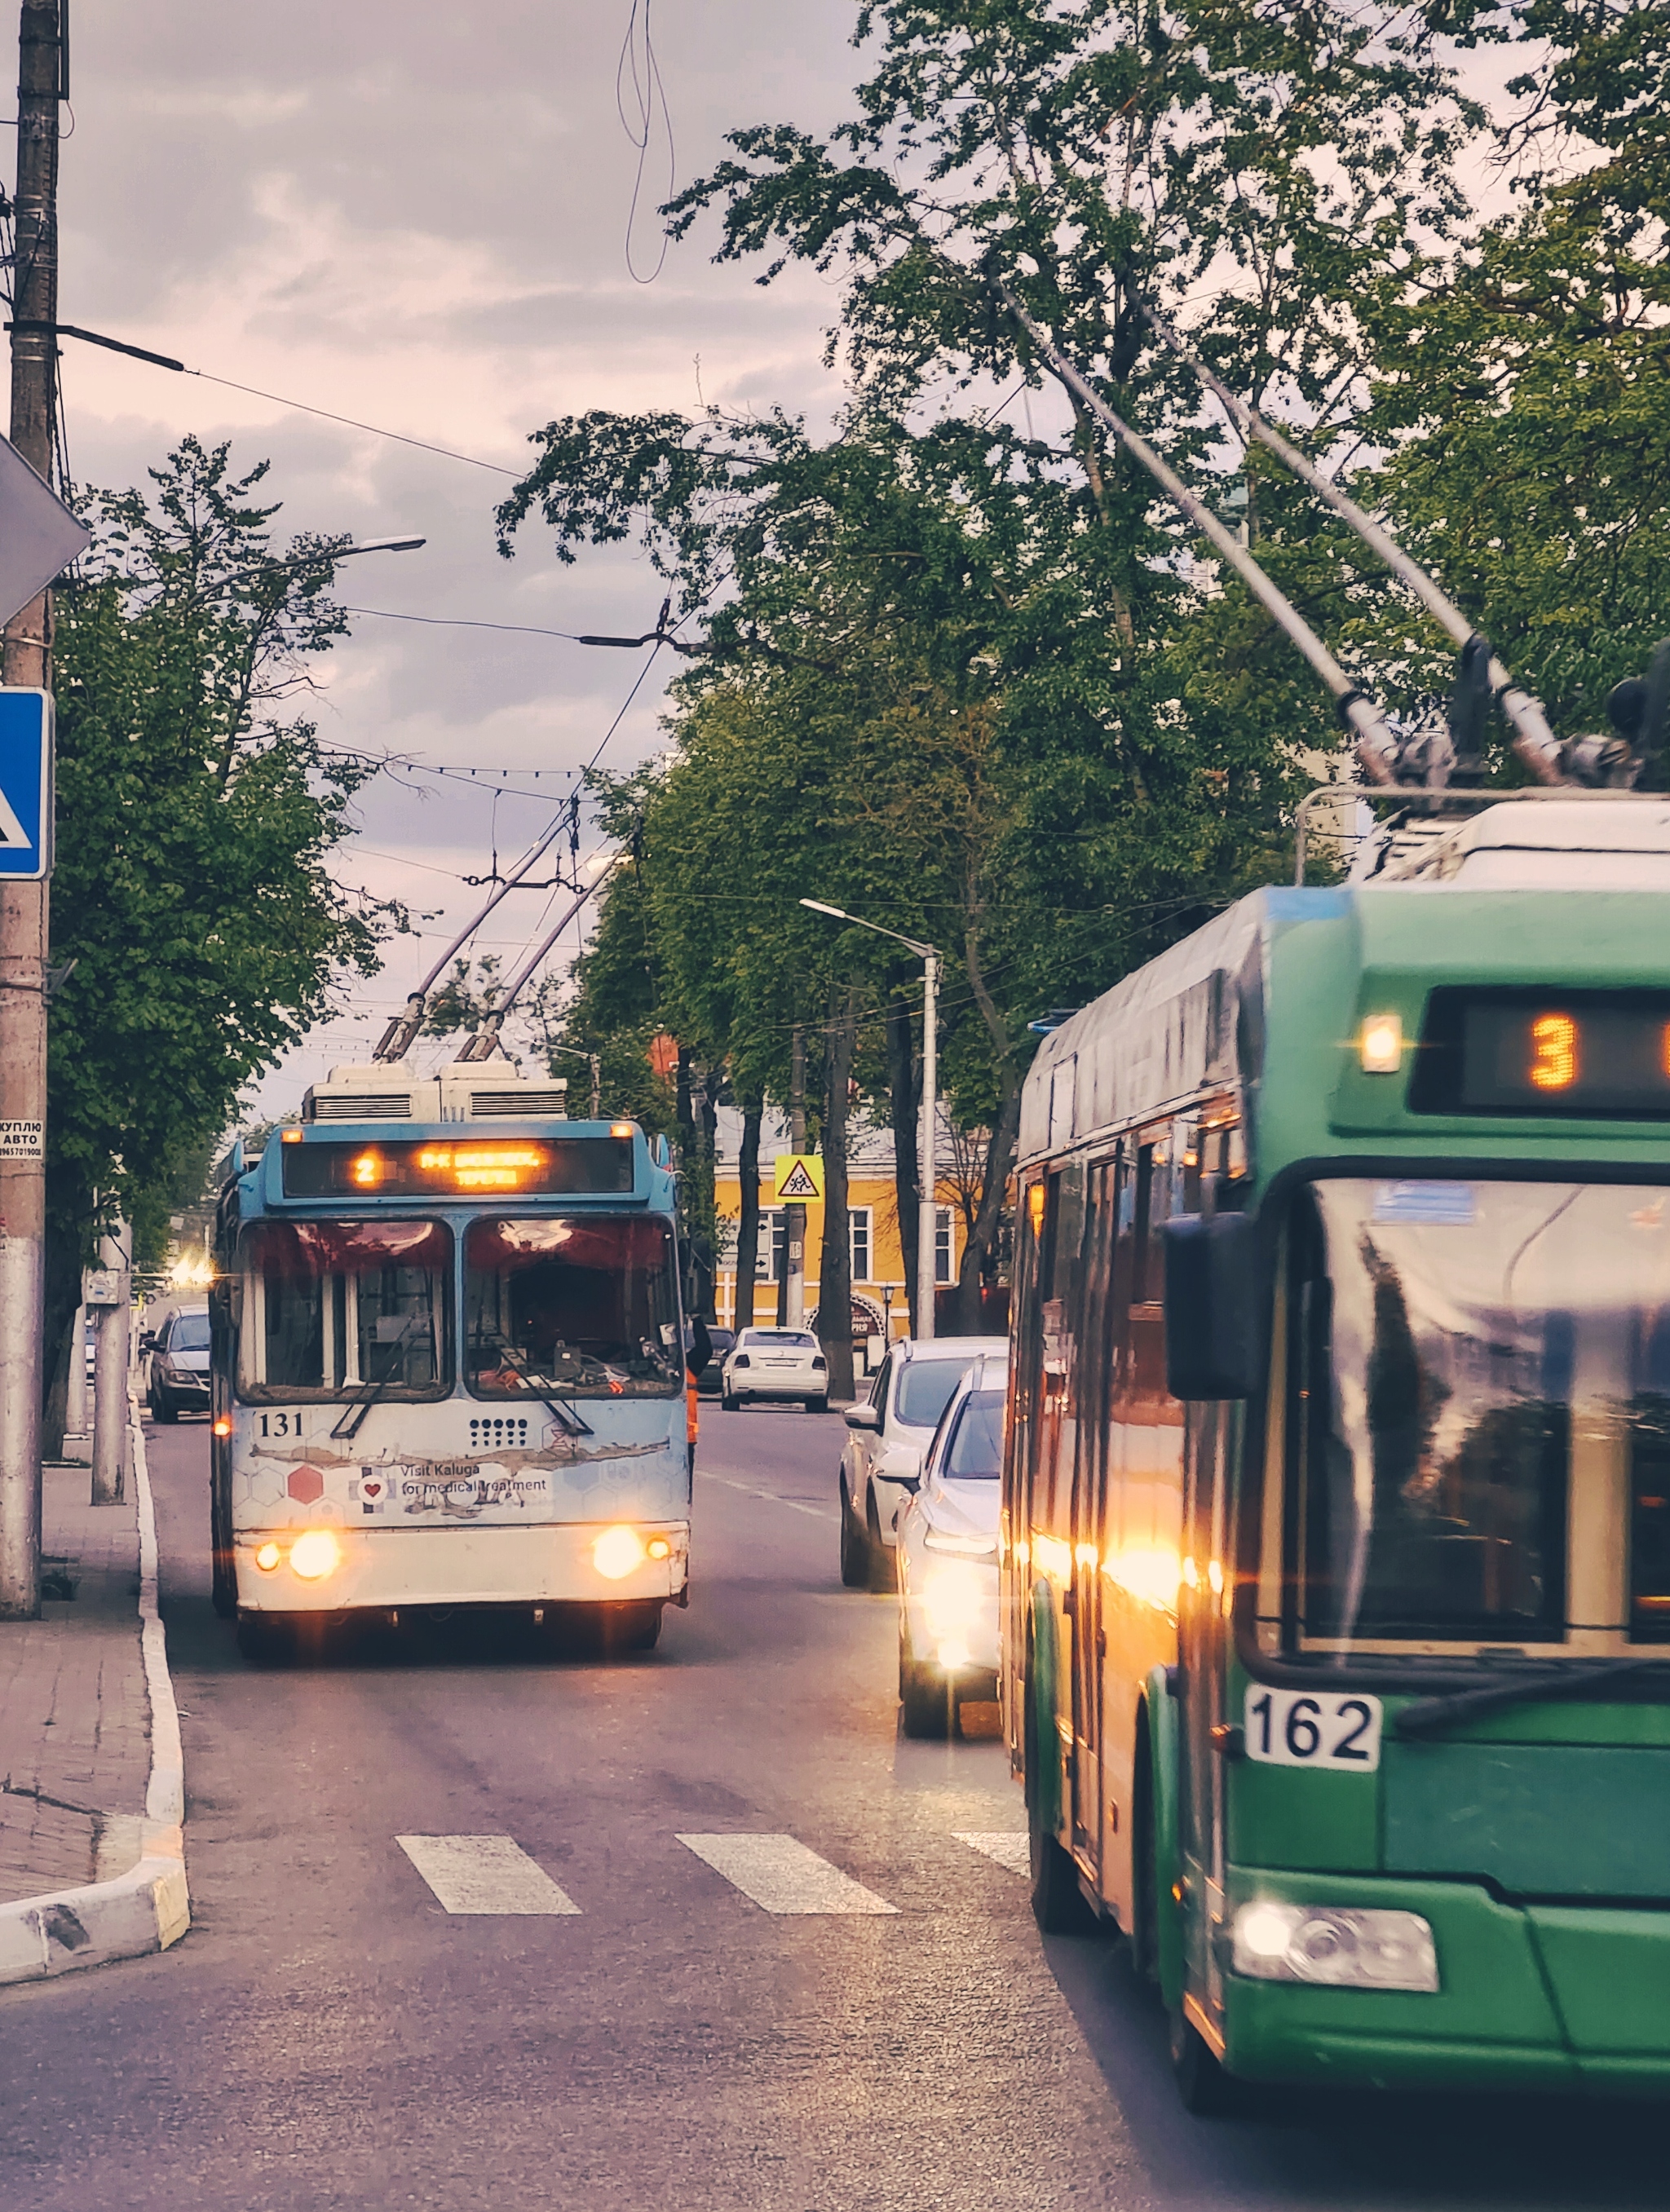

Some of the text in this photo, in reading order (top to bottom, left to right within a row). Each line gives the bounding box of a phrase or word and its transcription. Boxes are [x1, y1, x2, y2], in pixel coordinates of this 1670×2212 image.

[1532, 1017, 1575, 1086] 3
[0, 1122, 42, 1132] КУПЛЮ
[3, 1134, 38, 1145] АВТО
[356, 1159, 375, 1182] 2
[259, 1412, 303, 1437] 131
[400, 1463, 480, 1477] Visit Kaluga
[402, 1481, 420, 1495] for
[424, 1481, 477, 1495] medical
[1252, 1693, 1372, 1761] 162
